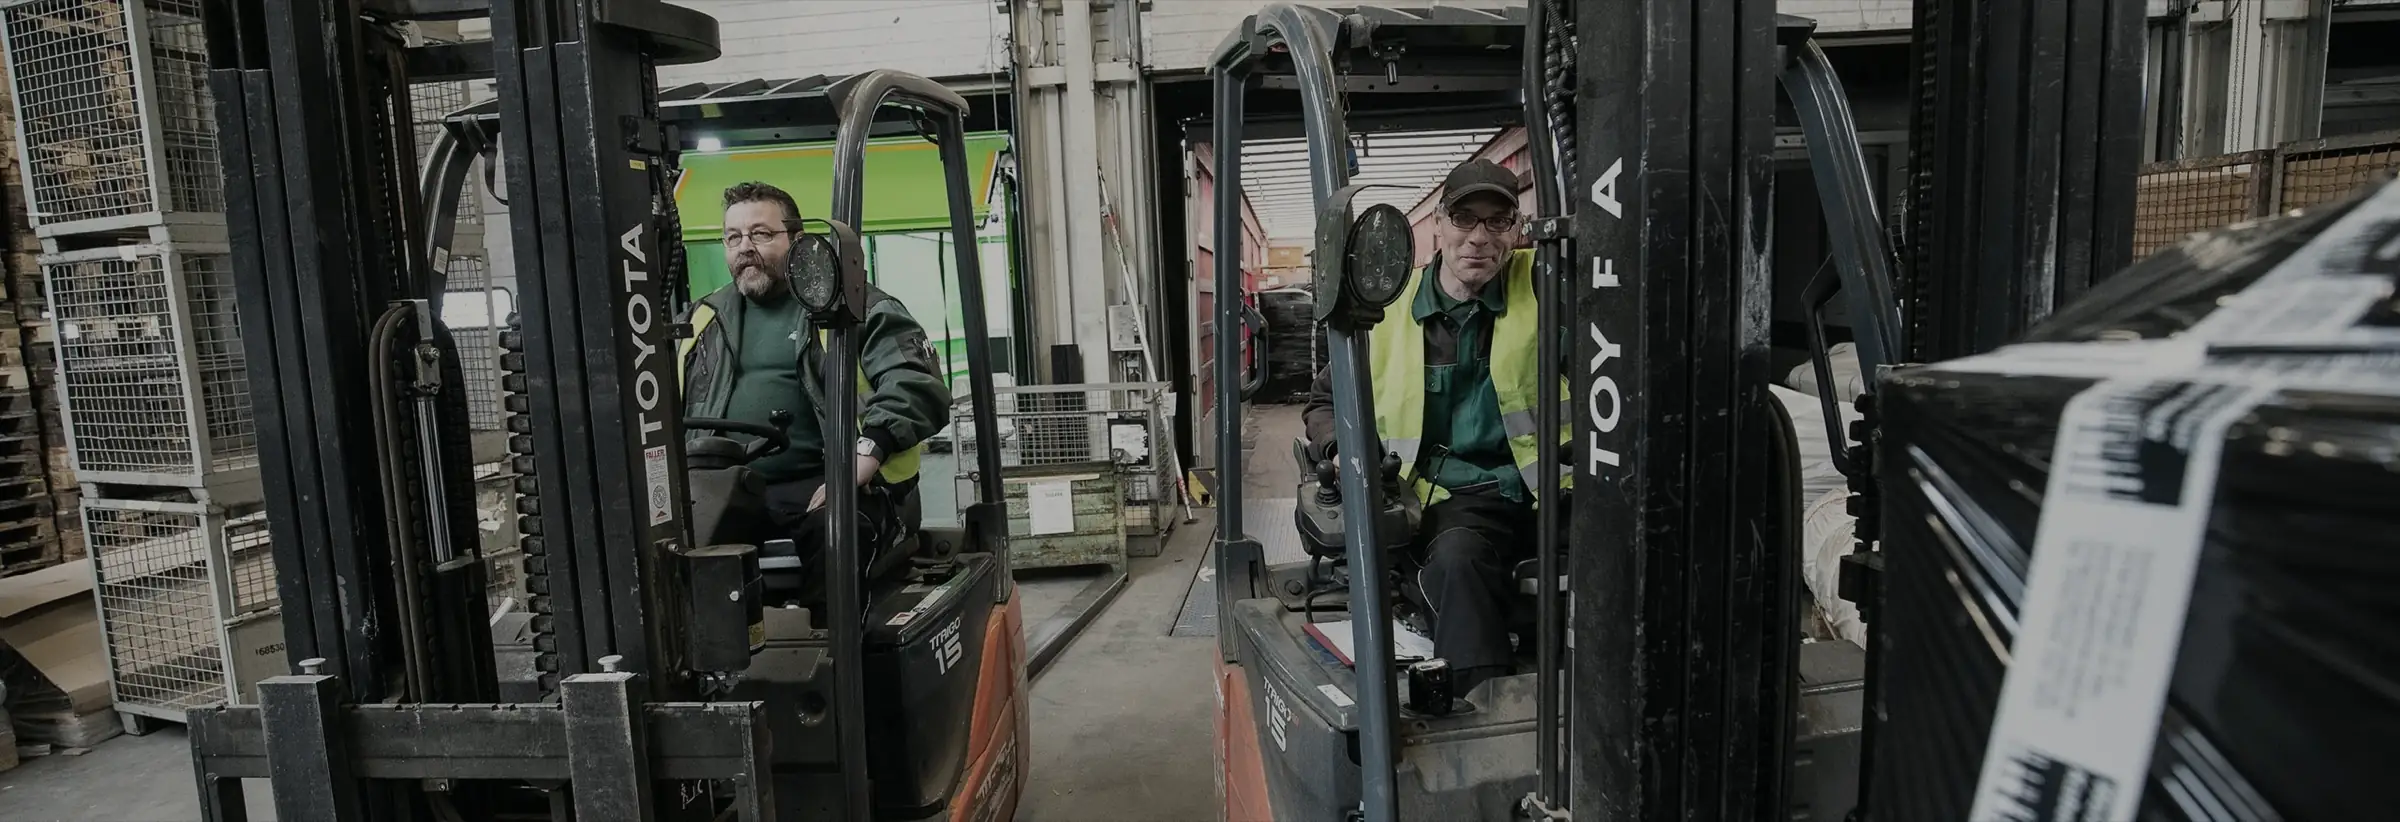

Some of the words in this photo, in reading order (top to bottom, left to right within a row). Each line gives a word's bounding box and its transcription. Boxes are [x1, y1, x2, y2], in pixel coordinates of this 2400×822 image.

[621, 222, 663, 446] TOYOTA
[935, 631, 963, 676] 15
[1265, 695, 1287, 752] 15
